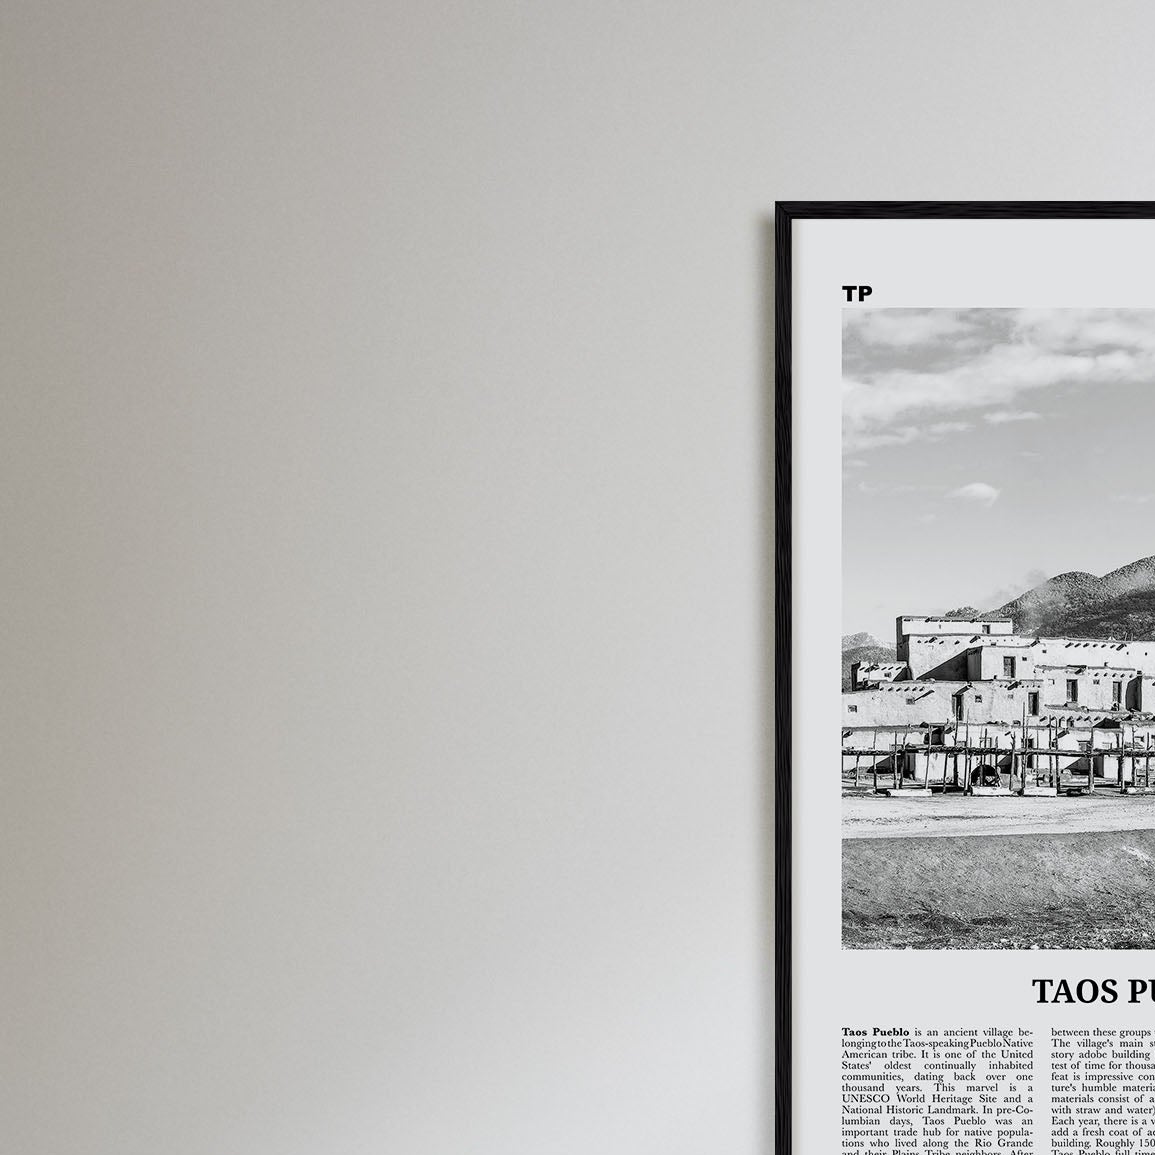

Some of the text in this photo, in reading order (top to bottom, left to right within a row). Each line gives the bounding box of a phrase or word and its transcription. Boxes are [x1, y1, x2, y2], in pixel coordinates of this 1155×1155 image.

[842, 286, 872, 302] TP
[1032, 979, 1118, 1004] TAOS
[841, 1028, 868, 1036] Taos
[872, 1028, 910, 1036] Pueblo
[914, 1028, 922, 1036] is
[943, 1028, 978, 1036] ancient
[982, 1028, 1013, 1038] village
[1018, 1028, 1033, 1036] be-
[1051, 1028, 1090, 1036] between
[1092, 1028, 1117, 1036] these
[841, 1061, 1033, 1071] States' oldest continually inhabited
[841, 1072, 904, 1082] communities,
[914, 1072, 944, 1082] dating
[954, 1072, 976, 1081] back
[1051, 1072, 1069, 1081] feat
[1073, 1072, 1081, 1081] is
[1085, 1072, 1134, 1082] impressive
[841, 1083, 885, 1092] thousand
[934, 1083, 956, 1092] This
[966, 1083, 998, 1092] marvel
[1009, 1083, 1017, 1092] is
[1051, 1083, 1077, 1092] ture's
[1082, 1083, 1117, 1092] humble
[842, 1094, 890, 1103] UNESCO
[897, 1094, 926, 1103] World
[932, 1094, 973, 1105] Heritage
[978, 1094, 998, 1103] Site
[1003, 1094, 1022, 1103] and
[1051, 1094, 1094, 1103] materials
[1098, 1094, 1130, 1103] consist
[1133, 1094, 1144, 1103] of
[842, 1106, 1033, 1116] National Historic Landmark. In pre-Co-
[841, 1117, 880, 1125] lumbian
[889, 1117, 913, 1127] days,
[922, 1117, 945, 1125] Taos
[954, 1117, 986, 1125] Pueblo
[842, 1128, 1033, 1138] important trade hub for native popula-
[1051, 1139, 1092, 1149] building.
[1096, 1139, 1135, 1149] Roughly
